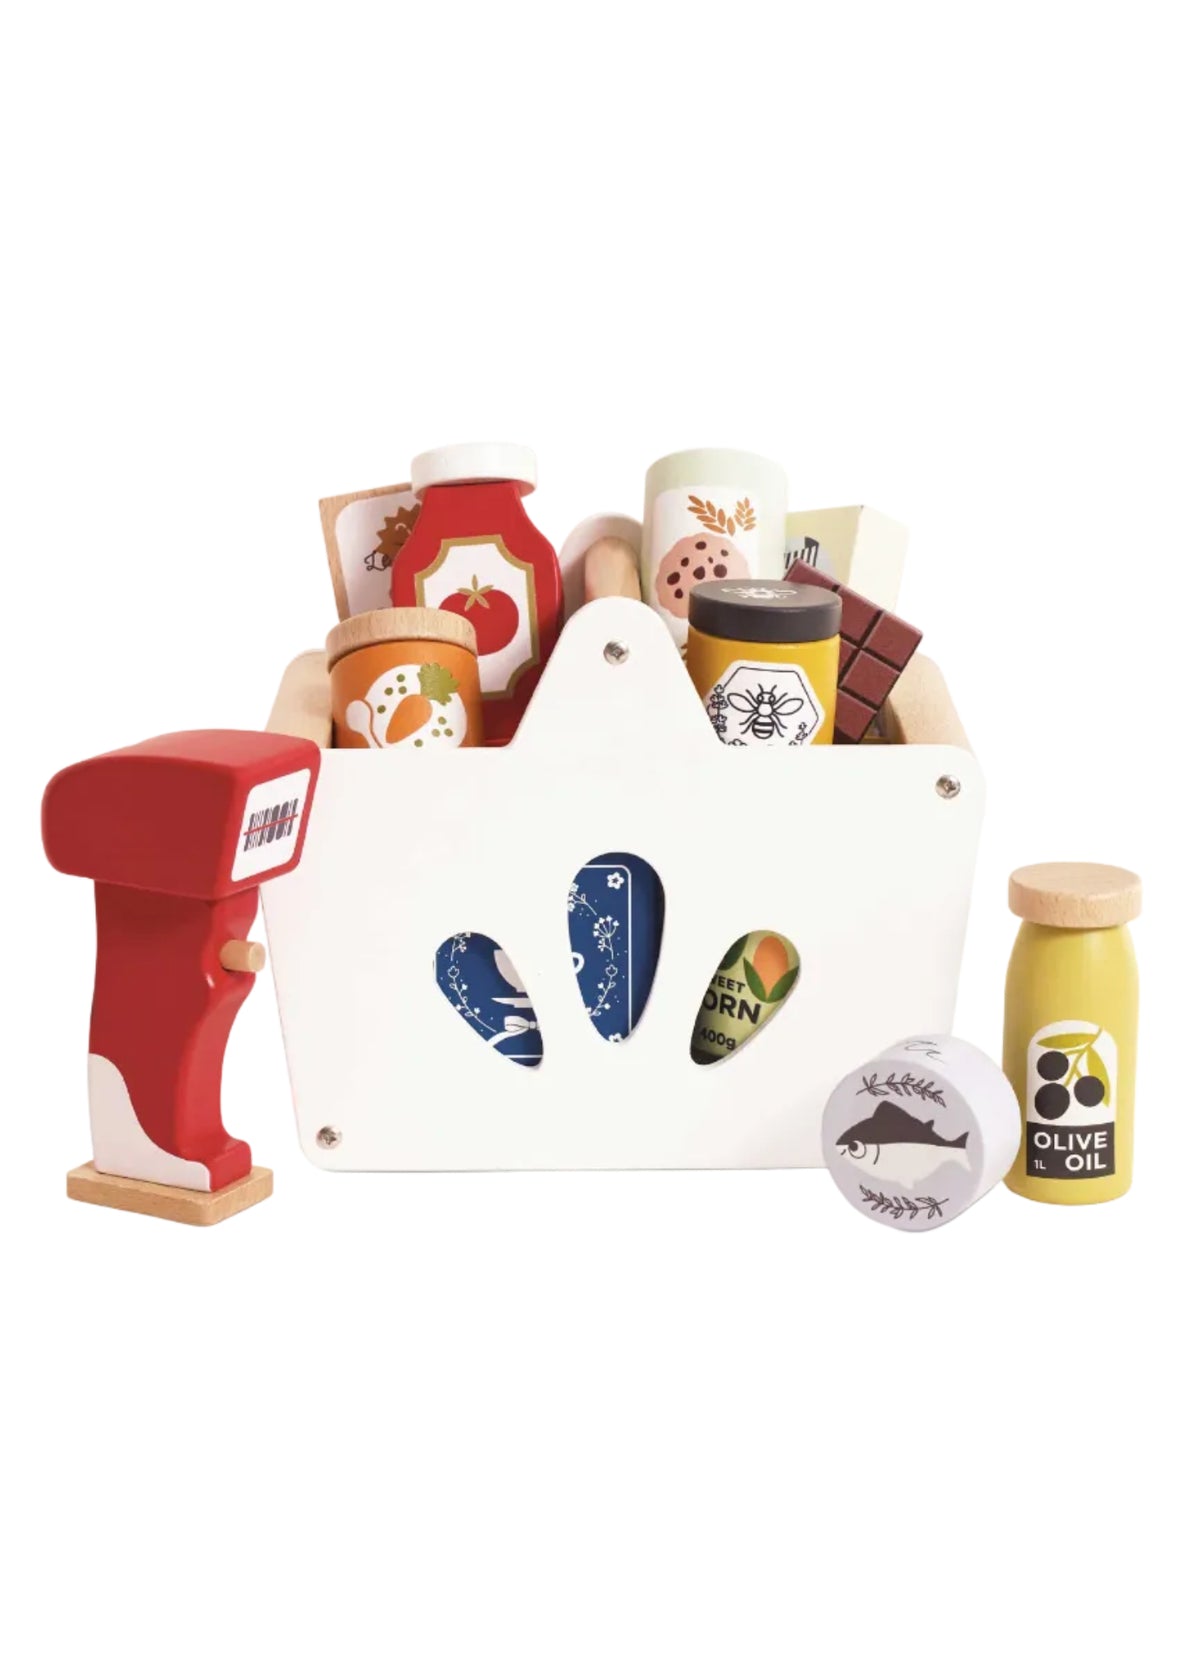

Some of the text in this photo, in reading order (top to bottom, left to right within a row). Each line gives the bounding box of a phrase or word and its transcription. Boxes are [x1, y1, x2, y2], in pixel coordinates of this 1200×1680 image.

[701, 1027, 736, 1051] 400g
[1034, 1131, 1108, 1151] OLIVE
[1034, 1160, 1047, 1170] 1L
[1065, 1152, 1107, 1172] OIL
